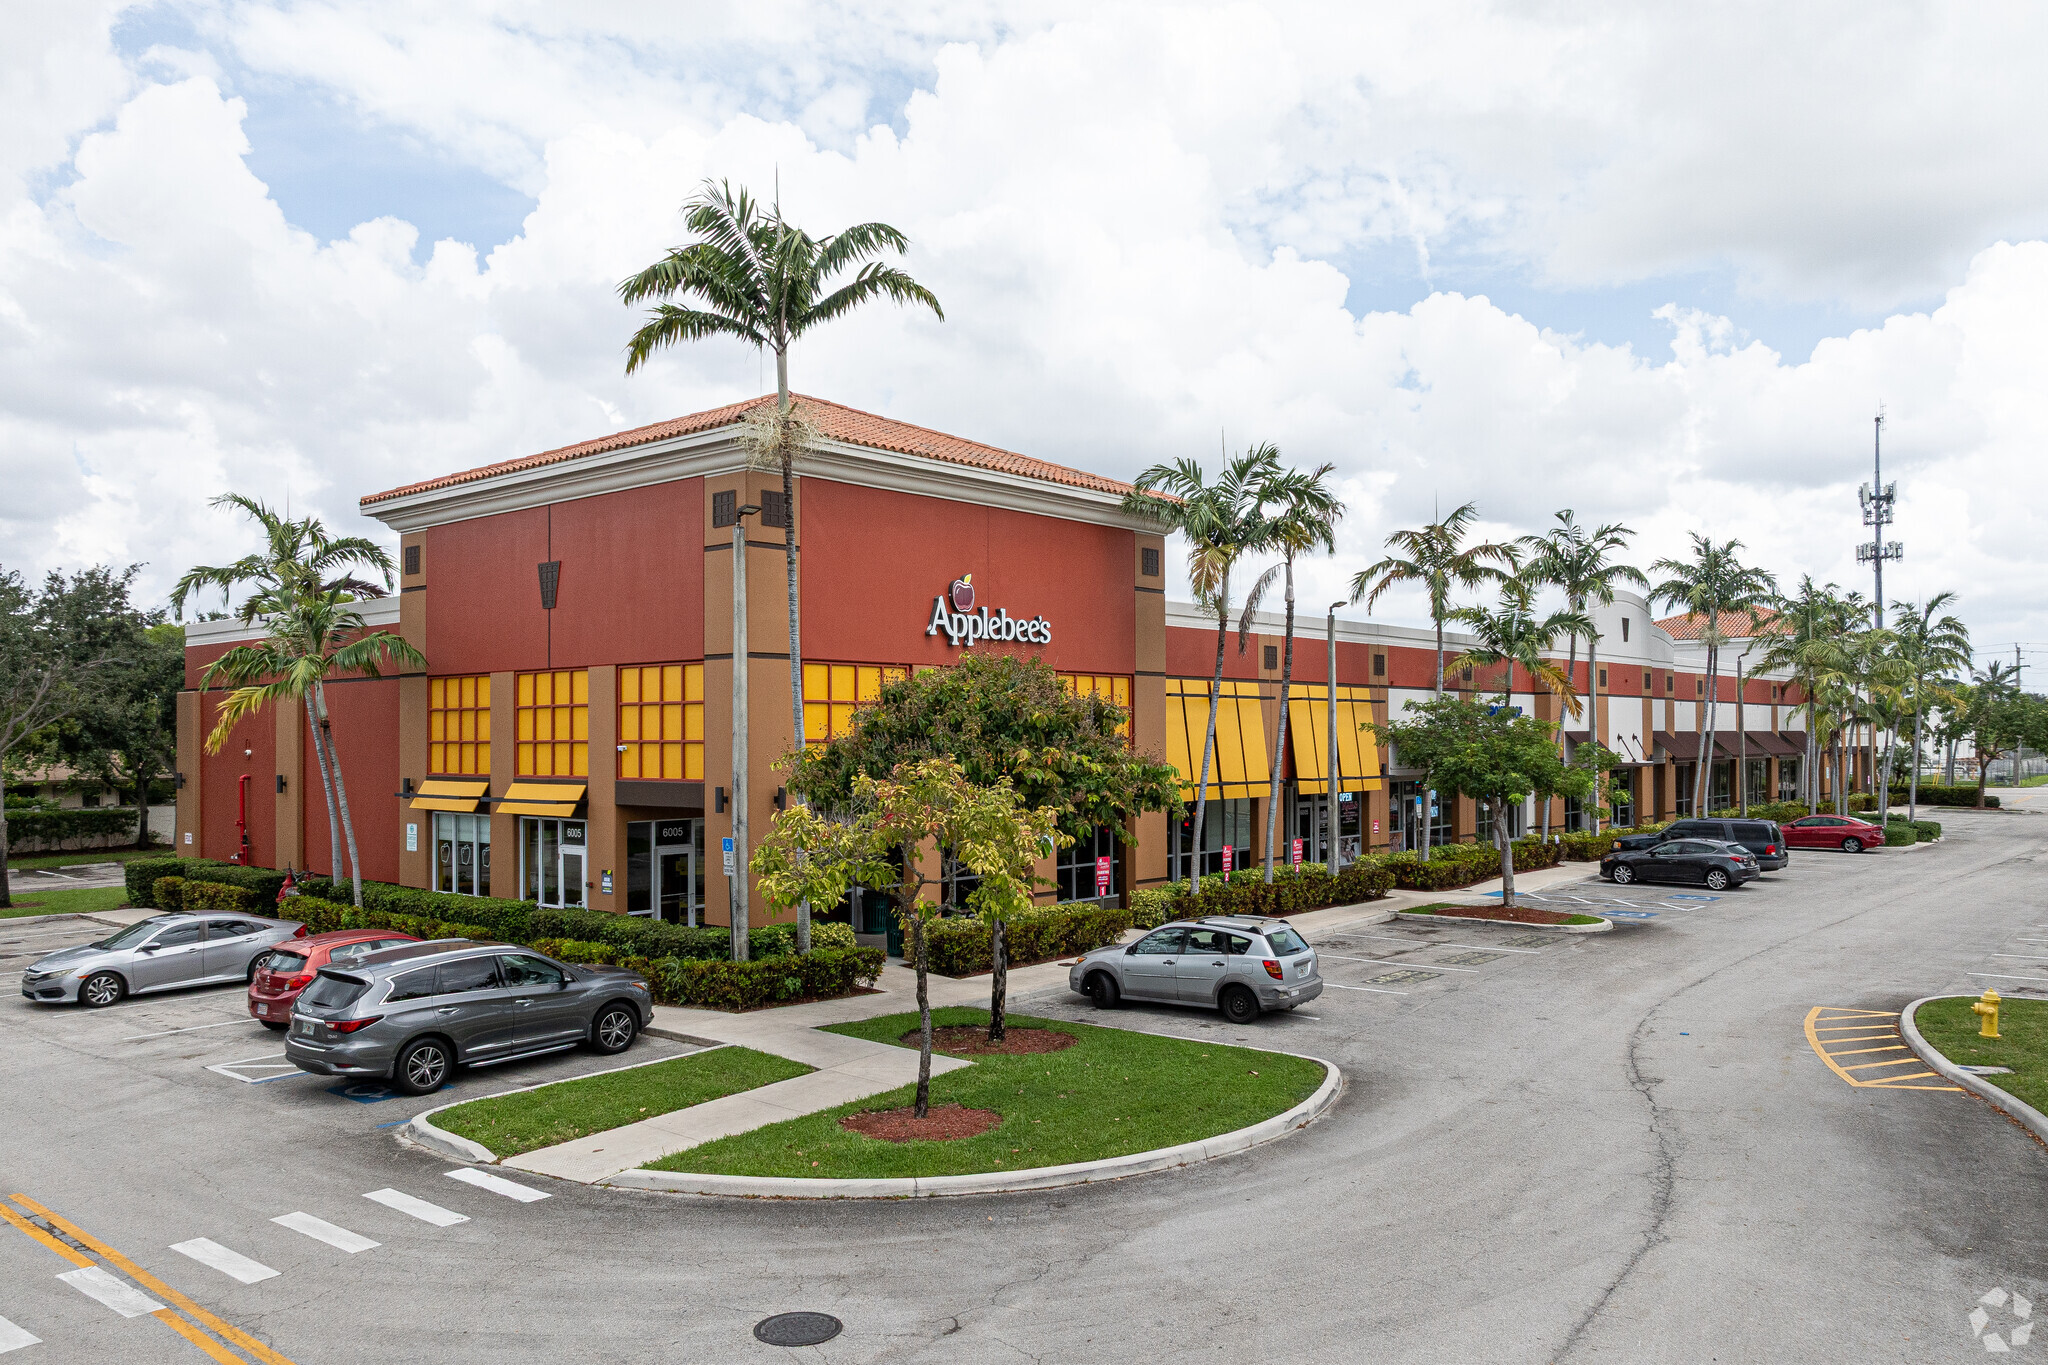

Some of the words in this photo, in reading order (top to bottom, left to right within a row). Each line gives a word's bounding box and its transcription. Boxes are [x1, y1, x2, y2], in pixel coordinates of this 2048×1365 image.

[925, 595, 1052, 646] Applebee's
[1339, 792, 1353, 802] OPEN
[566, 828, 582, 838] 6005
[662, 827, 684, 838] 6005
[1101, 886, 1105, 896] 1
